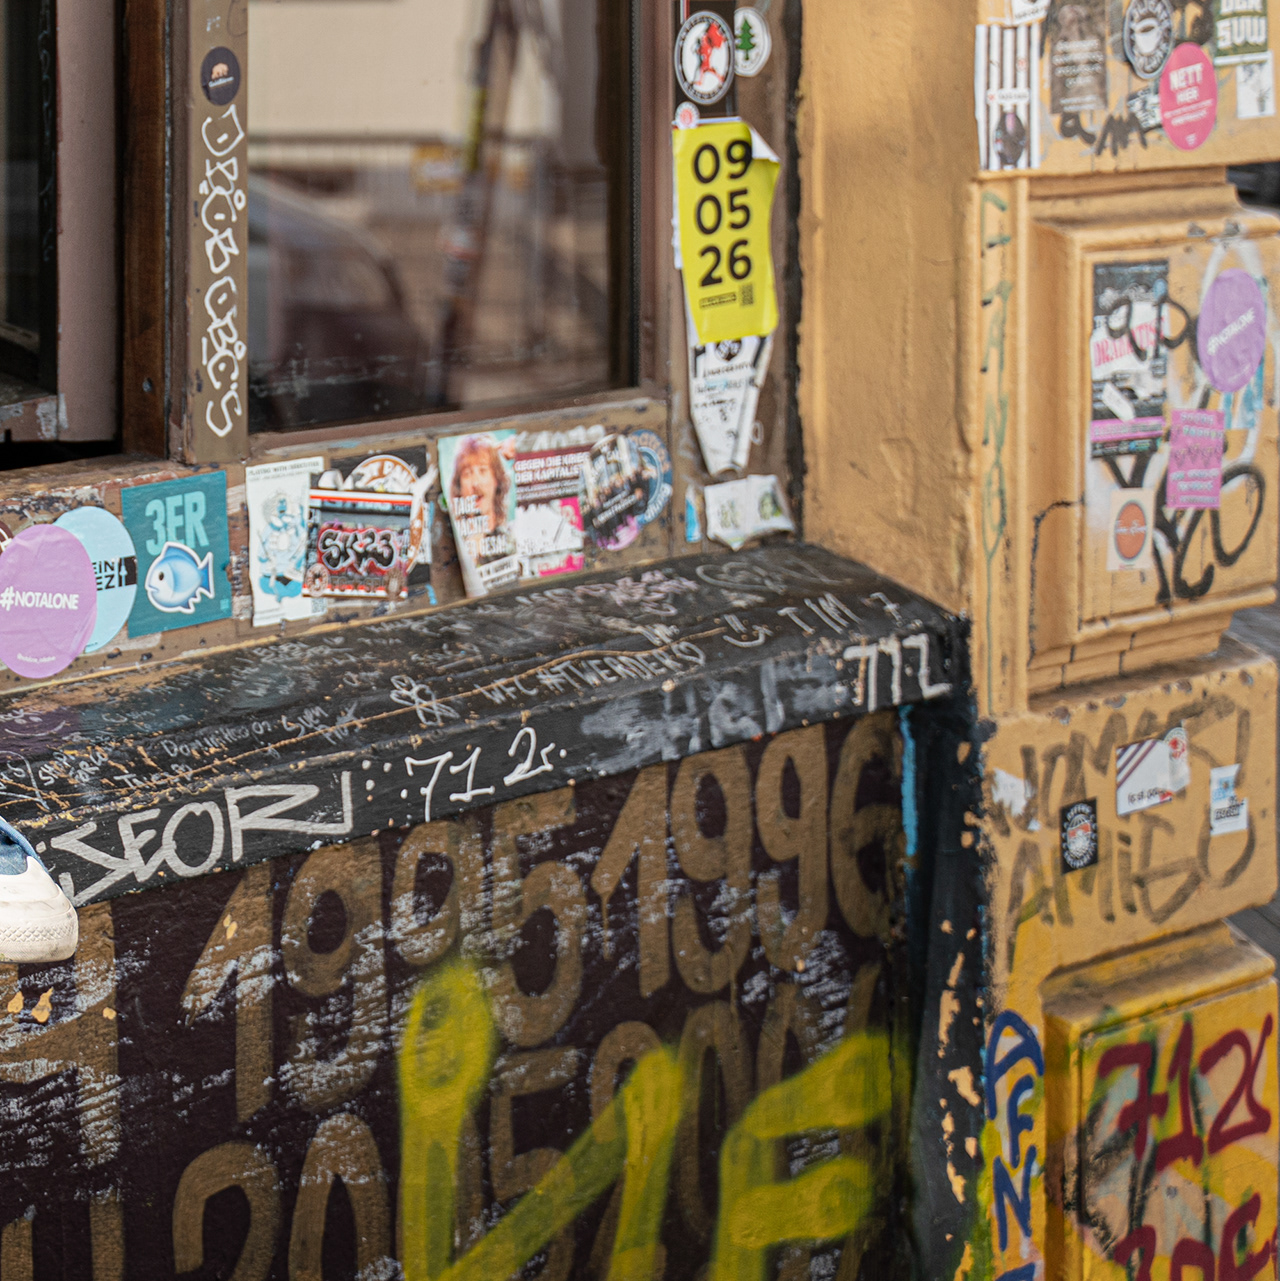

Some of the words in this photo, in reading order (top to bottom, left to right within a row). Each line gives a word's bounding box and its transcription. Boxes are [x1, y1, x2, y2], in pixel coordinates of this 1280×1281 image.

[692, 139, 753, 185] 09
[696, 187, 752, 236] 05
[699, 238, 753, 287] 26
[144, 490, 210, 556] 3ER
[0, 586, 80, 611] #NOTALONE
